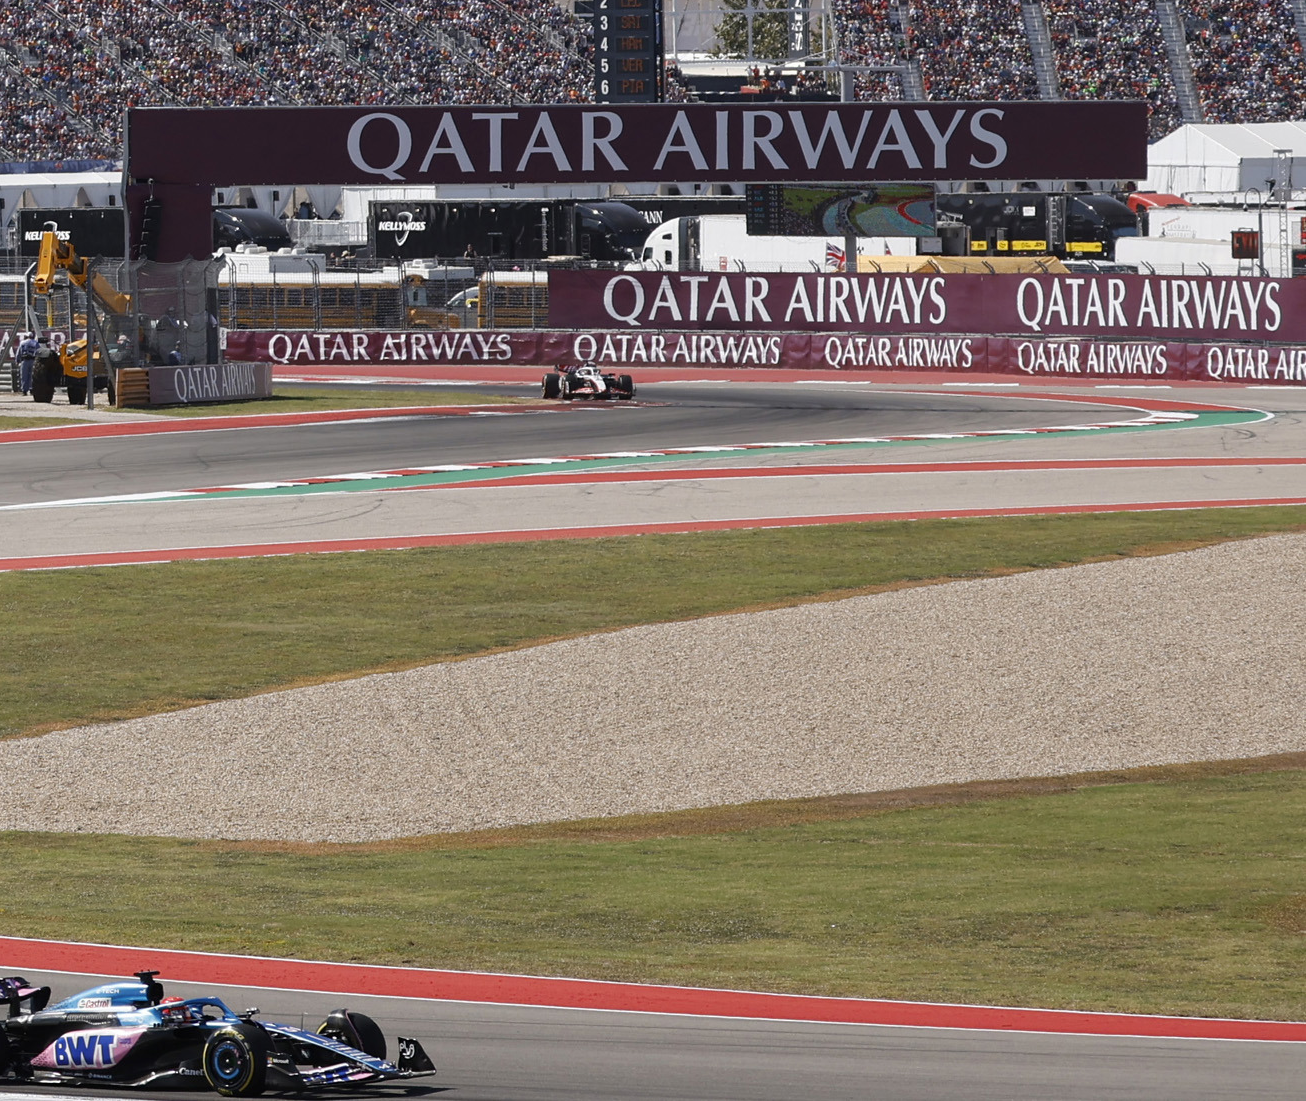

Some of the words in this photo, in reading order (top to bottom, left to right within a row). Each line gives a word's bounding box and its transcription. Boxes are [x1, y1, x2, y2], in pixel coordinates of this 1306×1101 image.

[600, 15, 608, 31] 3
[600, 37, 609, 52] 4
[601, 58, 609, 73] 5
[622, 59, 643, 72] VER
[601, 79, 609, 95] 6
[622, 80, 644, 93] PIA
[346, 111, 629, 180] QATAR
[652, 108, 1009, 172] AIRWAYS
[378, 221, 426, 231] KELLYMOSS
[603, 275, 773, 326] QATAR
[784, 276, 947, 325] AIRWAYS
[1016, 277, 1129, 332] QATAR
[1136, 279, 1282, 332] AIRWAYS
[268, 333, 371, 364] QATAR
[379, 333, 512, 361] AIRWAYS
[573, 334, 667, 363] QATAR
[672, 335, 782, 365] AIRWAYS
[824, 336, 893, 369] QATAR
[895, 338, 973, 368] AIRWAYS
[1017, 341, 1081, 375] QATAR
[1086, 343, 1168, 375] AIRWAYS
[1207, 346, 1270, 380] QATAR
[174, 367, 220, 403] QATAR
[221, 363, 256, 396] AIRWAYS
[85, 998, 111, 1009] Castrol
[54, 1034, 116, 1067] BWT
